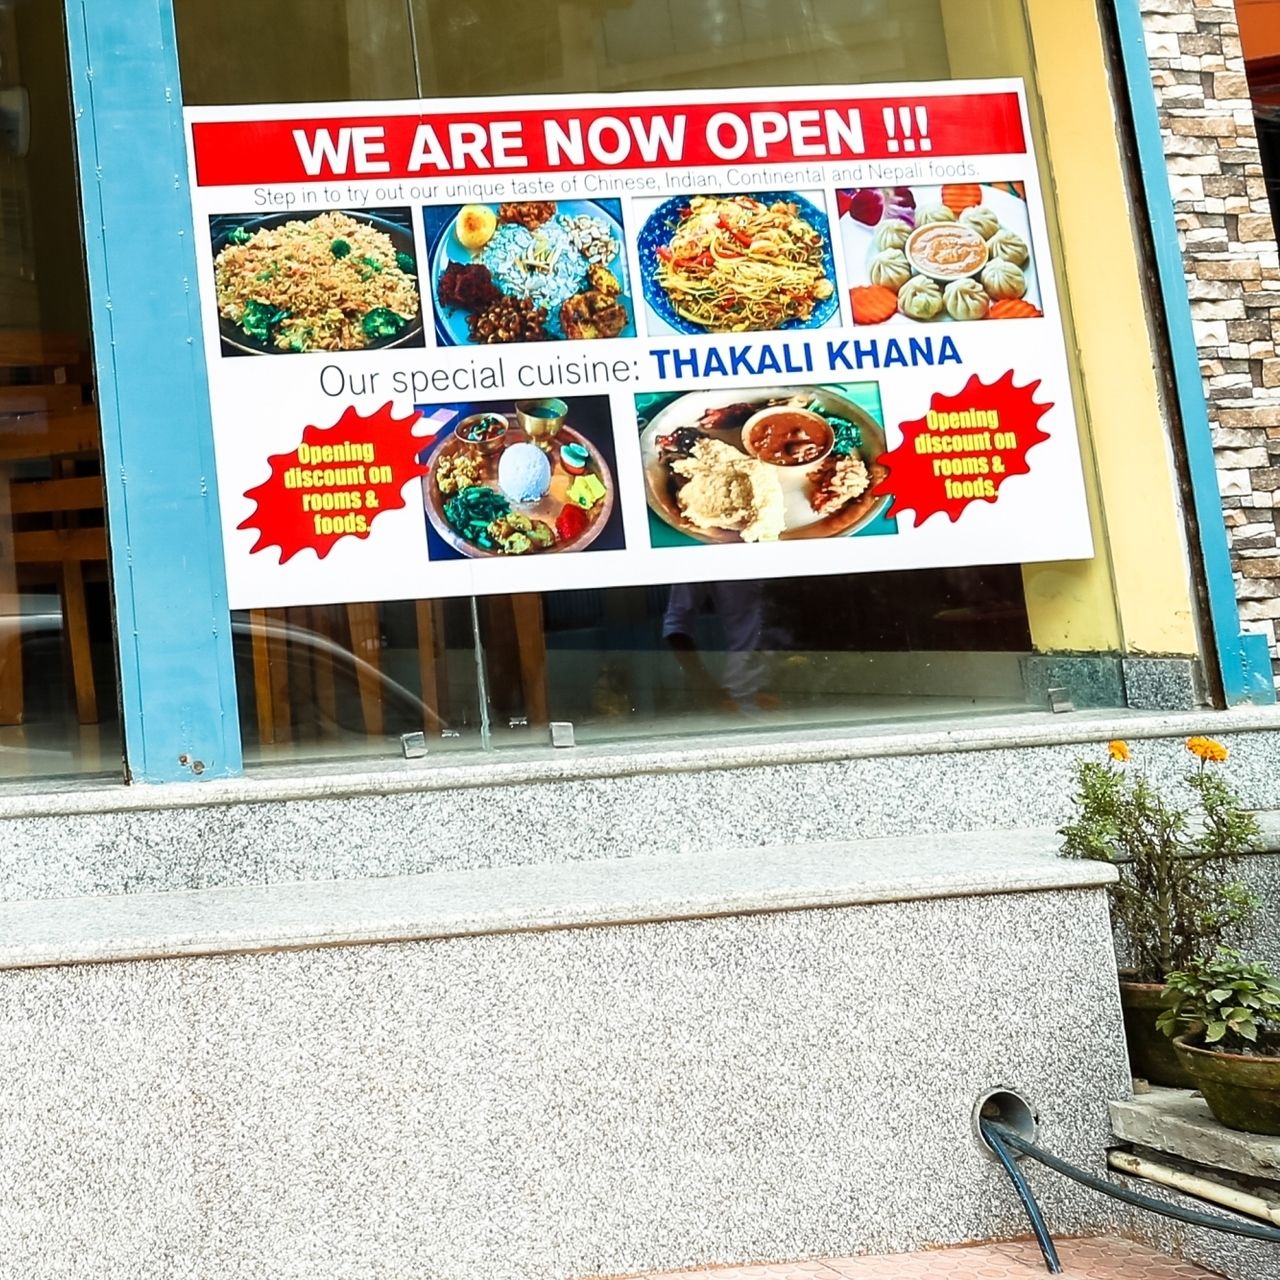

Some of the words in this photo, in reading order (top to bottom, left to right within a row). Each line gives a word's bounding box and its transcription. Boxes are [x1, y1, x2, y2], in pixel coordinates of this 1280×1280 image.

[292, 125, 391, 177] WE
[406, 119, 529, 173] ARE
[543, 113, 687, 167] NOW
[704, 106, 866, 161] OPEN
[882, 104, 933, 154] !!!
[253, 188, 297, 210] Step
[301, 187, 318, 204] in
[324, 187, 342, 203] to
[347, 185, 370, 207] try
[375, 184, 405, 201] out
[410, 184, 441, 199] our
[445, 179, 506, 202] unique
[511, 177, 555, 196] taste
[560, 176, 579, 194] of
[583, 173, 663, 193] Chinese,
[664, 169, 723, 191] Indian,
[727, 167, 827, 187] Continental
[832, 165, 862, 183] and
[867, 162, 924, 186] Nepali
[928, 160, 981, 179] foods.
[319, 364, 380, 397] Our
[392, 355, 506, 403] special
[516, 355, 641, 388] cuisine:
[649, 342, 815, 380] THAKALI
[827, 335, 964, 371] KHANA
[926, 407, 1000, 432] Opening
[297, 440, 375, 466] Opening
[914, 431, 993, 455] discount
[993, 431, 1018, 450] on
[283, 464, 367, 489] discount
[368, 465, 393, 485] on
[932, 456, 990, 477] rooms
[991, 455, 1006, 474] &
[302, 490, 363, 512] rooms
[364, 489, 380, 509] &
[944, 476, 1000, 500] foods.
[313, 511, 371, 536] foods.
